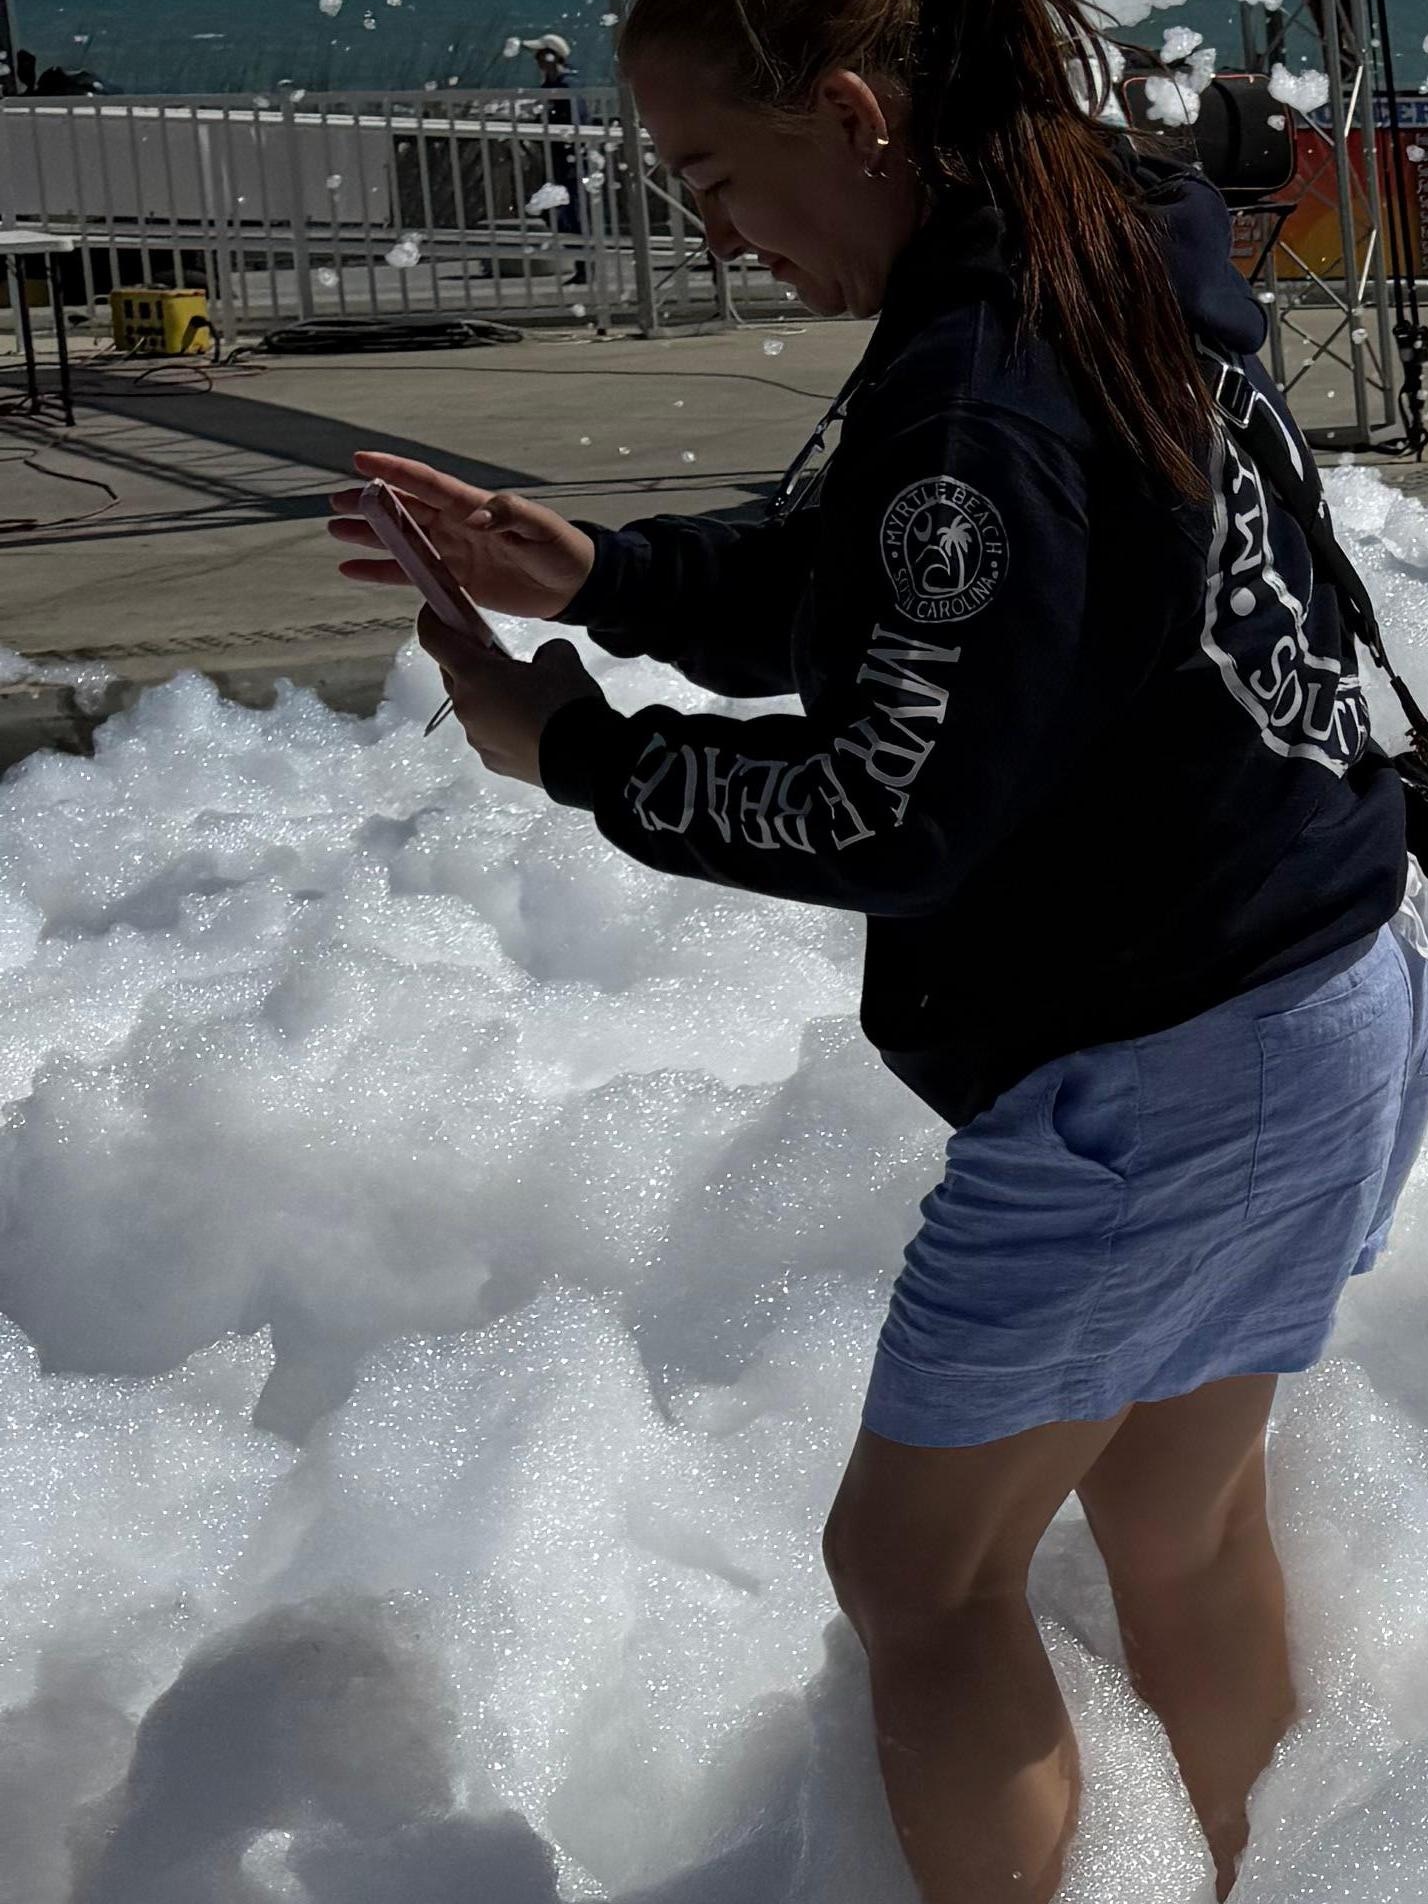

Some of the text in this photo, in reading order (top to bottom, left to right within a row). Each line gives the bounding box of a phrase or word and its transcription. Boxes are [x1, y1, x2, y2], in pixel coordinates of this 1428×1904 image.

[886, 482, 1003, 555] MYRTLE BEACH
[916, 576, 998, 619] CAROLINA
